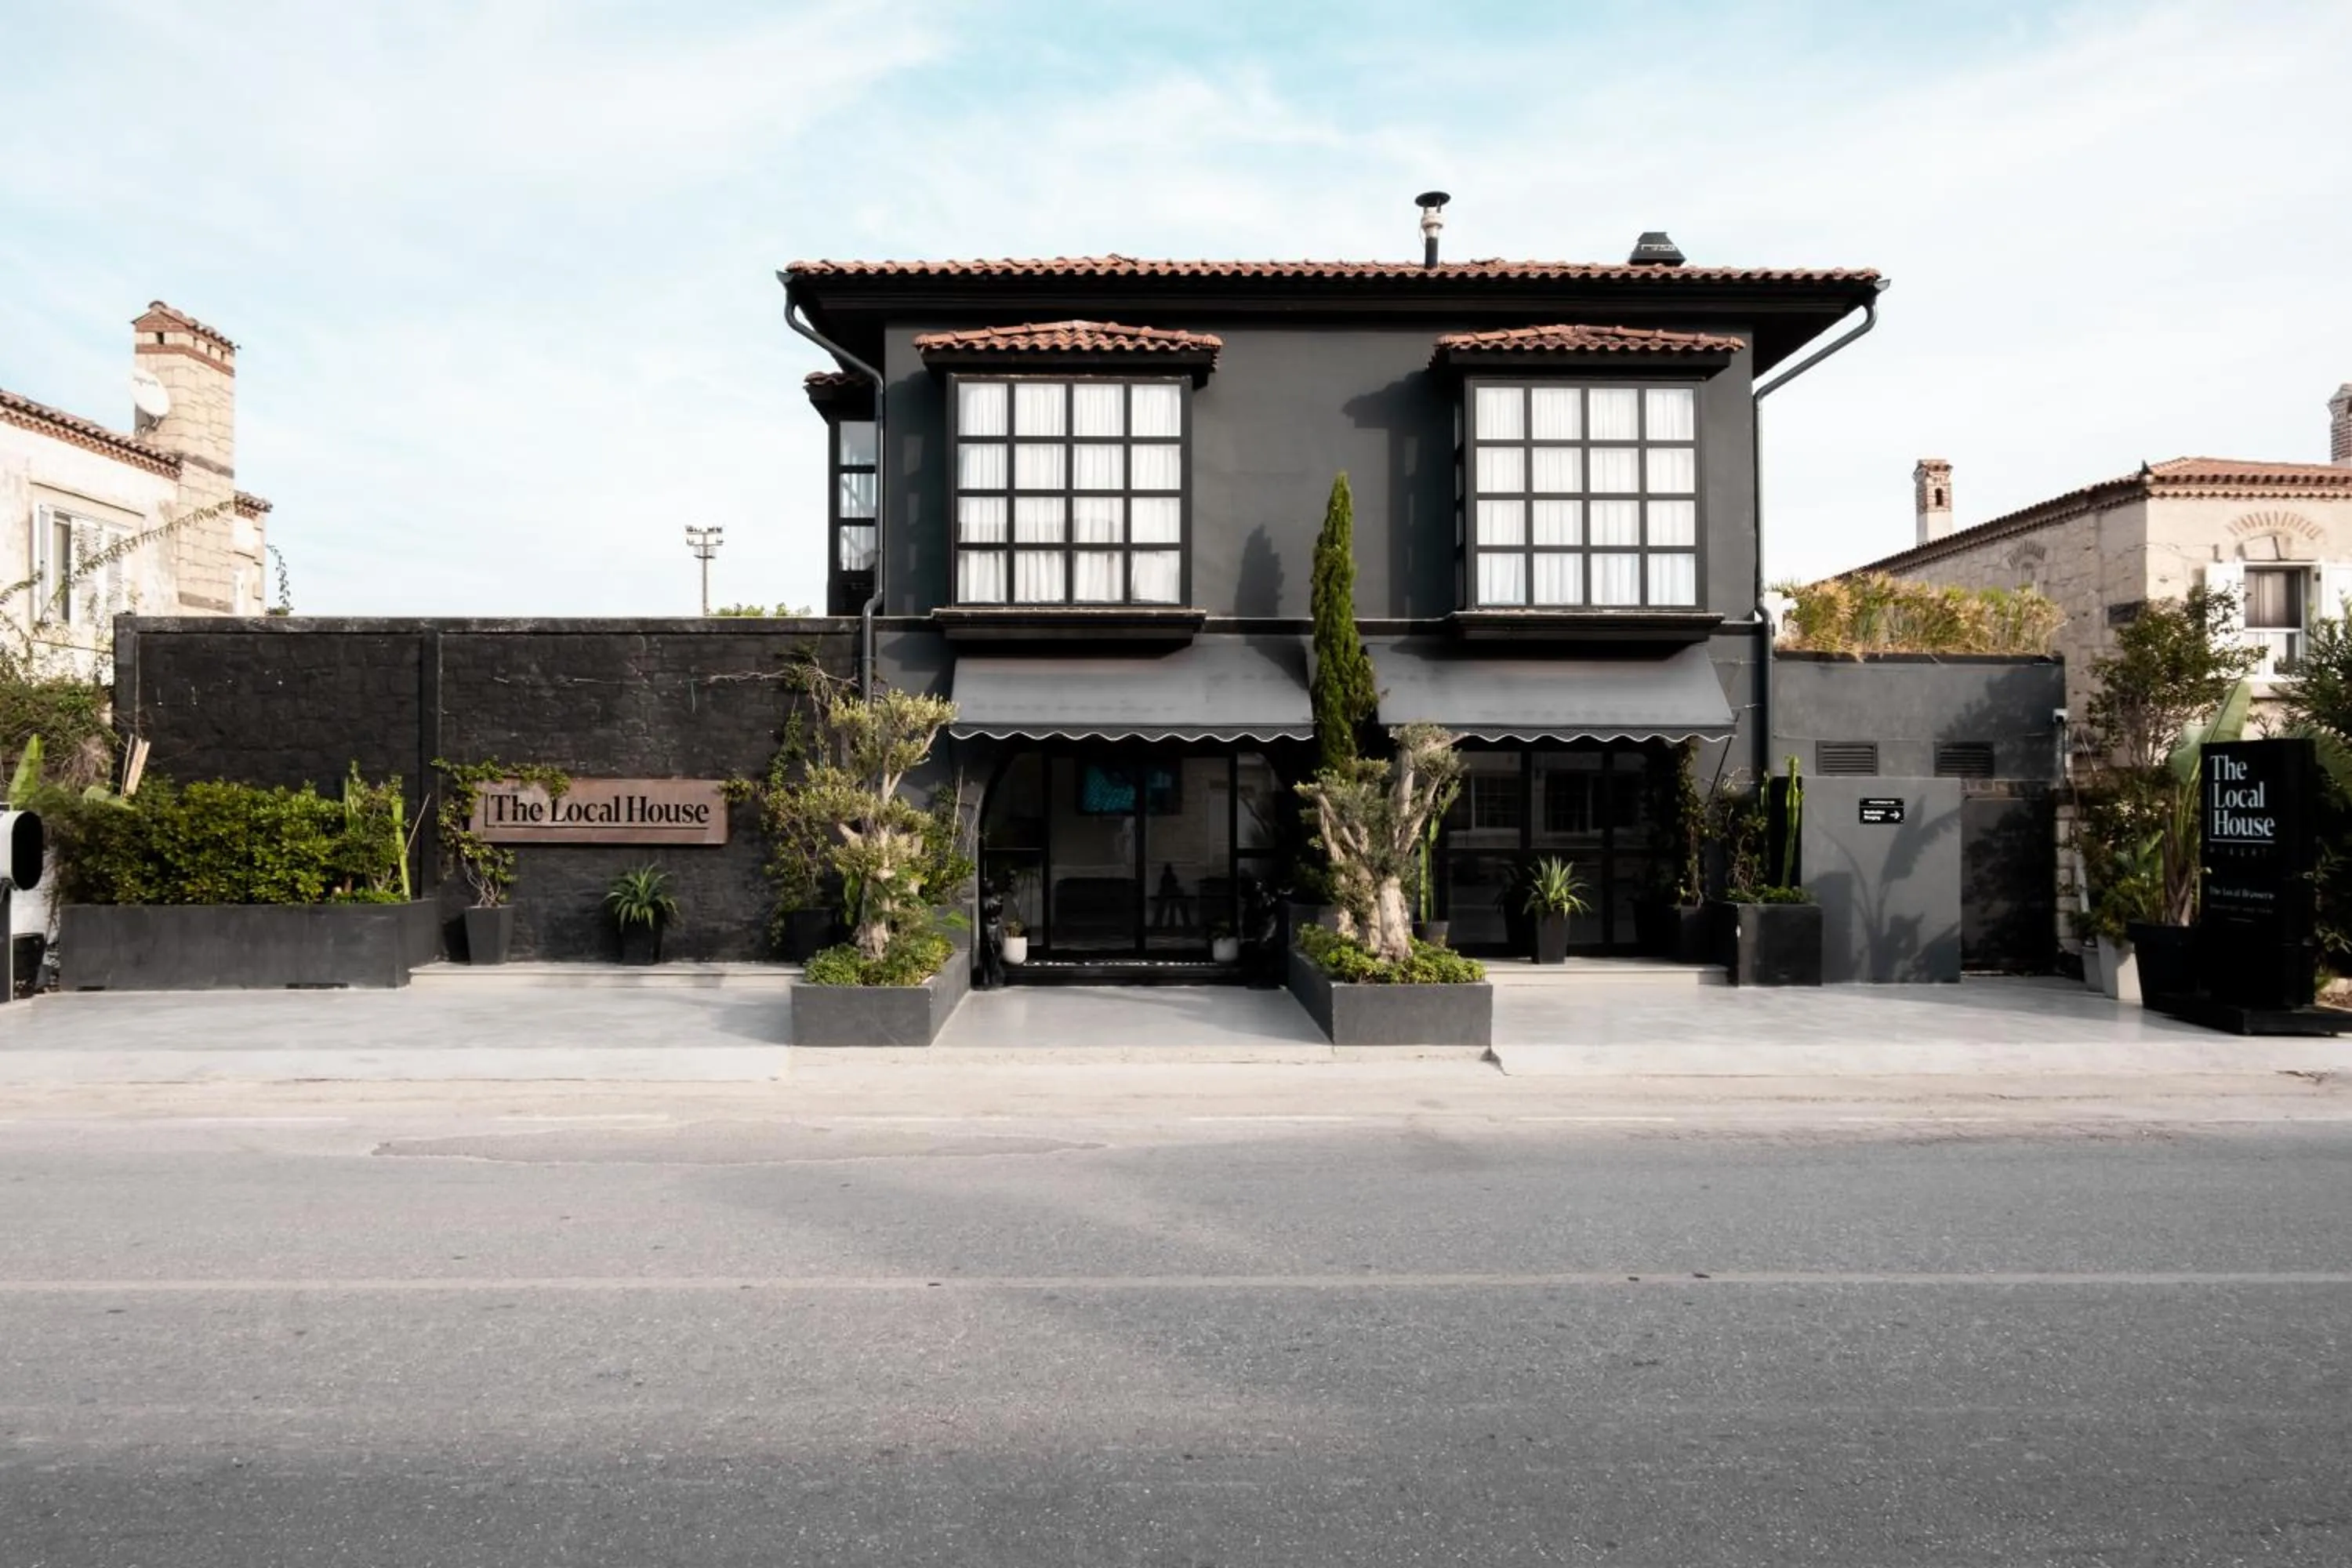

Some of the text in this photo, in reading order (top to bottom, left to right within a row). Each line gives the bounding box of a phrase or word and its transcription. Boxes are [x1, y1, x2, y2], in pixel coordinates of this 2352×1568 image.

[2209, 754, 2248, 780] The
[2213, 782, 2265, 808] Local
[491, 794, 710, 824] The Local House
[2213, 810, 2276, 837] House
